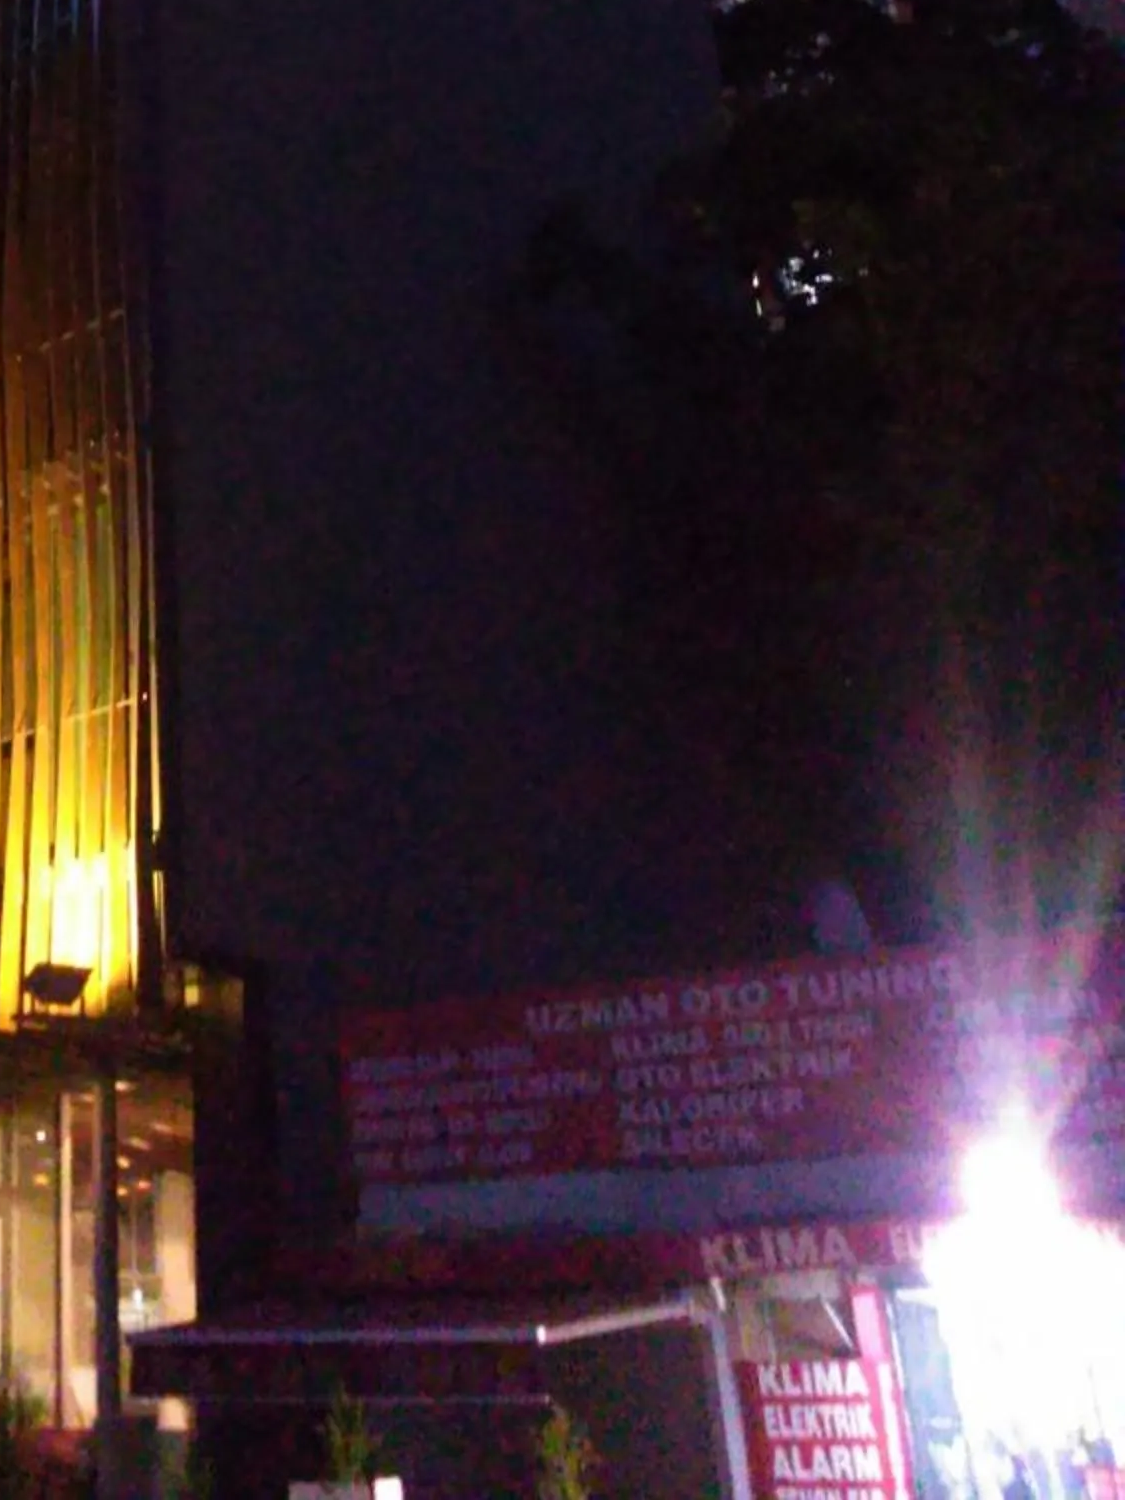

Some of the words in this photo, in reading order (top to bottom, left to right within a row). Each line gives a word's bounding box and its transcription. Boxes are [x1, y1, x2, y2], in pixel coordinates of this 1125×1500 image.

[525, 992, 670, 1033] UZMAN
[679, 979, 770, 1017] OTO
[614, 1063, 682, 1095] OTO
[758, 1360, 870, 1397] KLIMA
[763, 1402, 878, 1439] ELEKTRIK
[774, 1443, 883, 1481] ALARM
